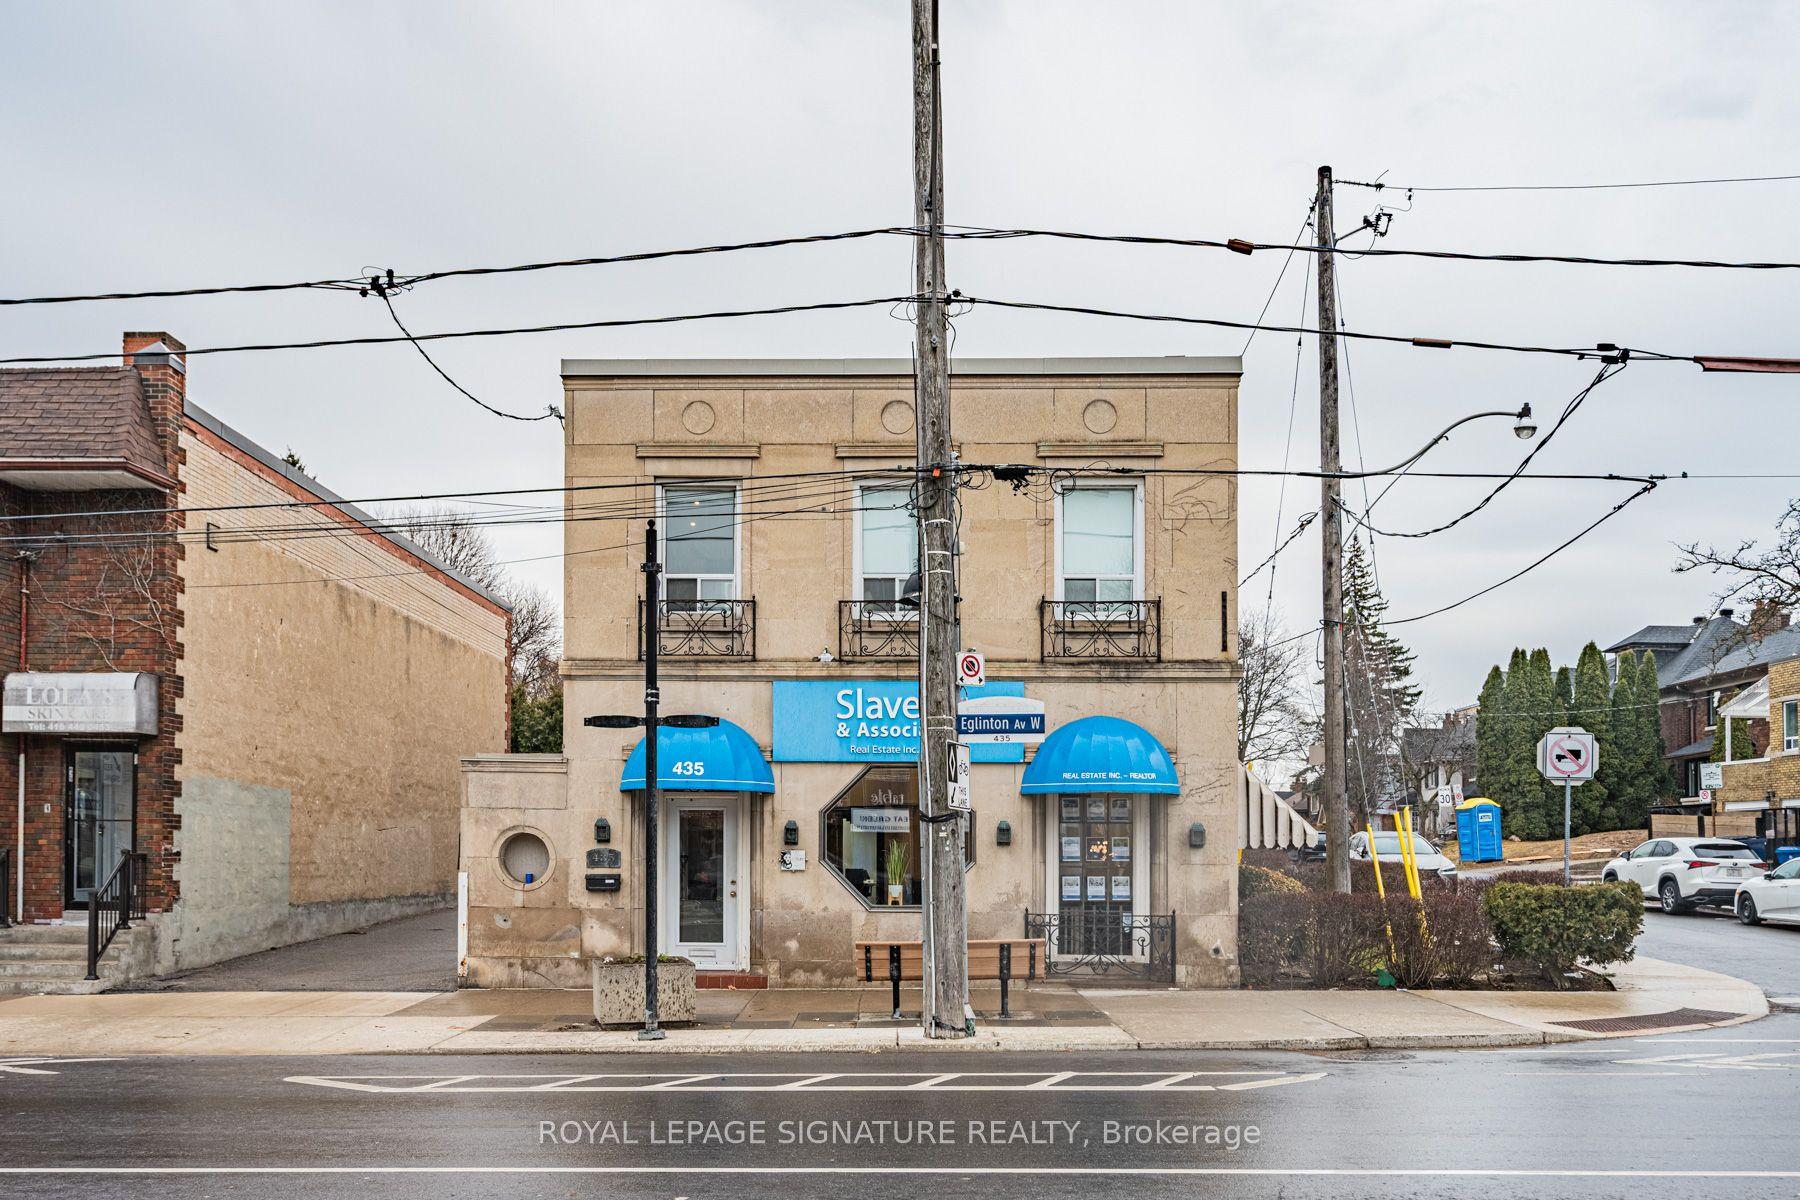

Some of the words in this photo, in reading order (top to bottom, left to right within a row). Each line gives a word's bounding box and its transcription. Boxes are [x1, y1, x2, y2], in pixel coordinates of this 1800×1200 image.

[836, 687, 920, 720] Slave
[27, 706, 64, 720] SKIN
[28, 723, 46, 731] Tel:
[836, 722, 850, 738] &
[856, 721, 921, 738] Associ
[961, 716, 1009, 732] Eglinton
[1014, 720, 1026, 730] Av
[1030, 717, 1041, 730] W
[850, 744, 870, 754] Real
[872, 744, 901, 754] Estate
[903, 744, 919, 754] Inc.
[672, 761, 705, 776] 435
[1129, 772, 1157, 780] REALTOR
[1440, 794, 1450, 804] 30
